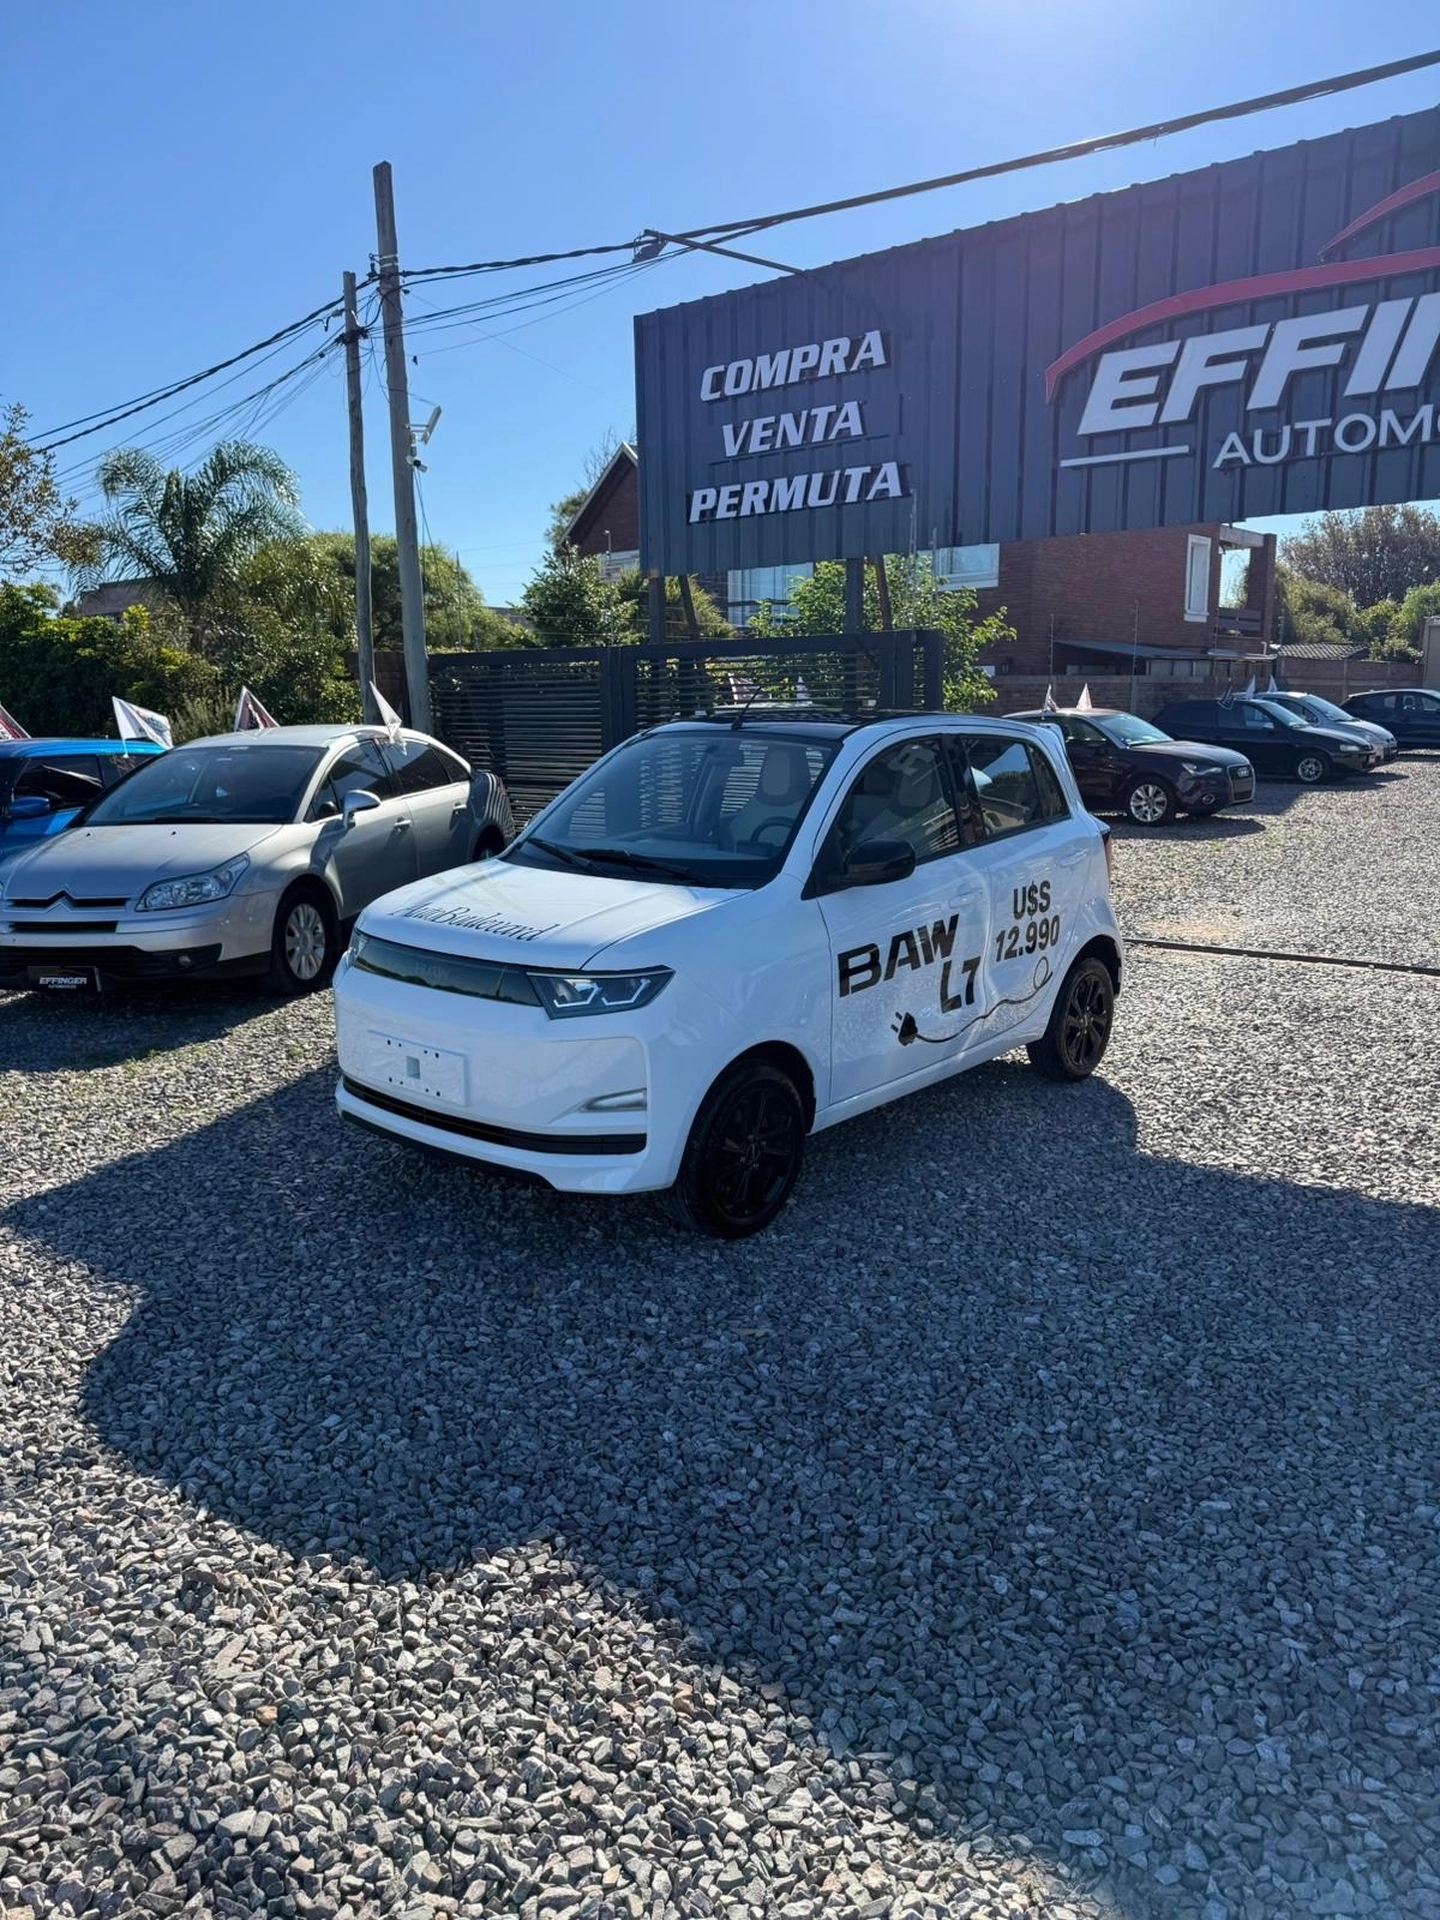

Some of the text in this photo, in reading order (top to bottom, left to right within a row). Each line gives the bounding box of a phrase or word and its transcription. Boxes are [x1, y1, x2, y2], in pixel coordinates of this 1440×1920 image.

[700, 330, 886, 402] COMPRA
[722, 401, 864, 457] VENTA
[1212, 404, 1440, 469] AUTOM
[689, 461, 903, 524] PERMUTA
[838, 913, 960, 998] BAW
[995, 915, 1061, 962] 12.990
